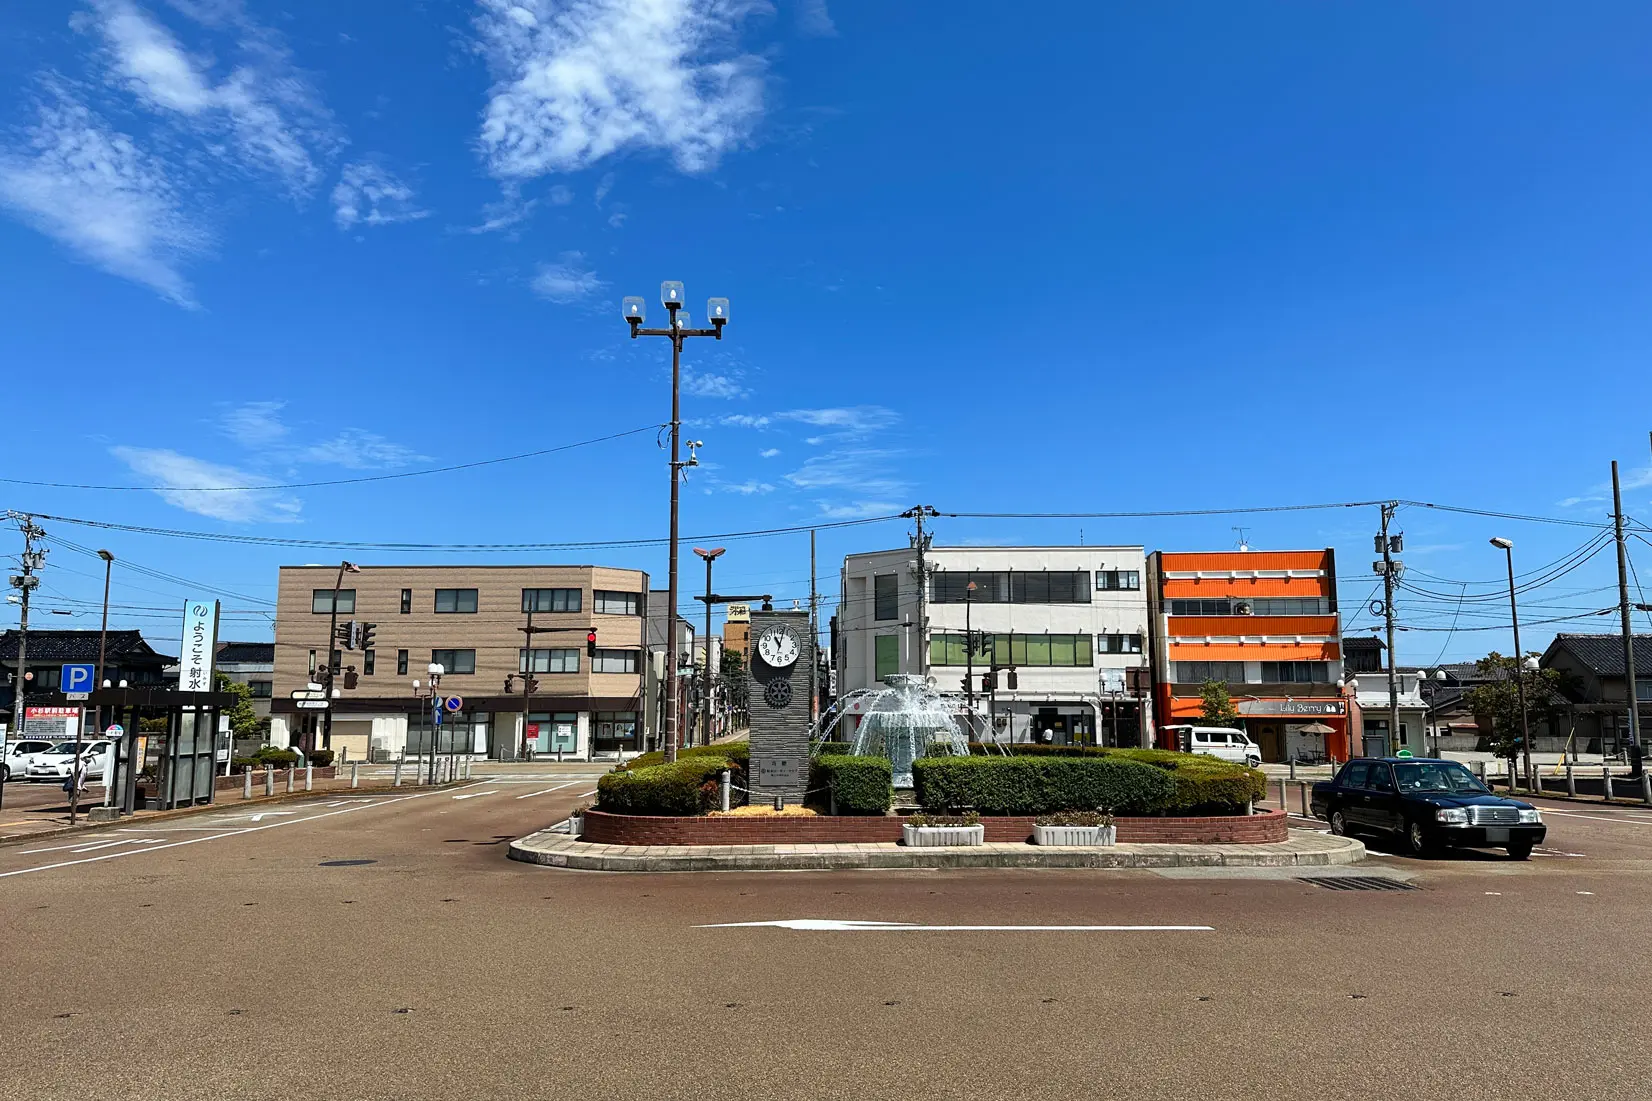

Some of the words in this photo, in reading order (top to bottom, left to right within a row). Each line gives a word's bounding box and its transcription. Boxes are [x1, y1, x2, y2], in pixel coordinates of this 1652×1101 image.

[188, 621, 204, 690] ようこそ射水
[69, 667, 88, 690] P
[1297, 703, 1322, 714] Berry
